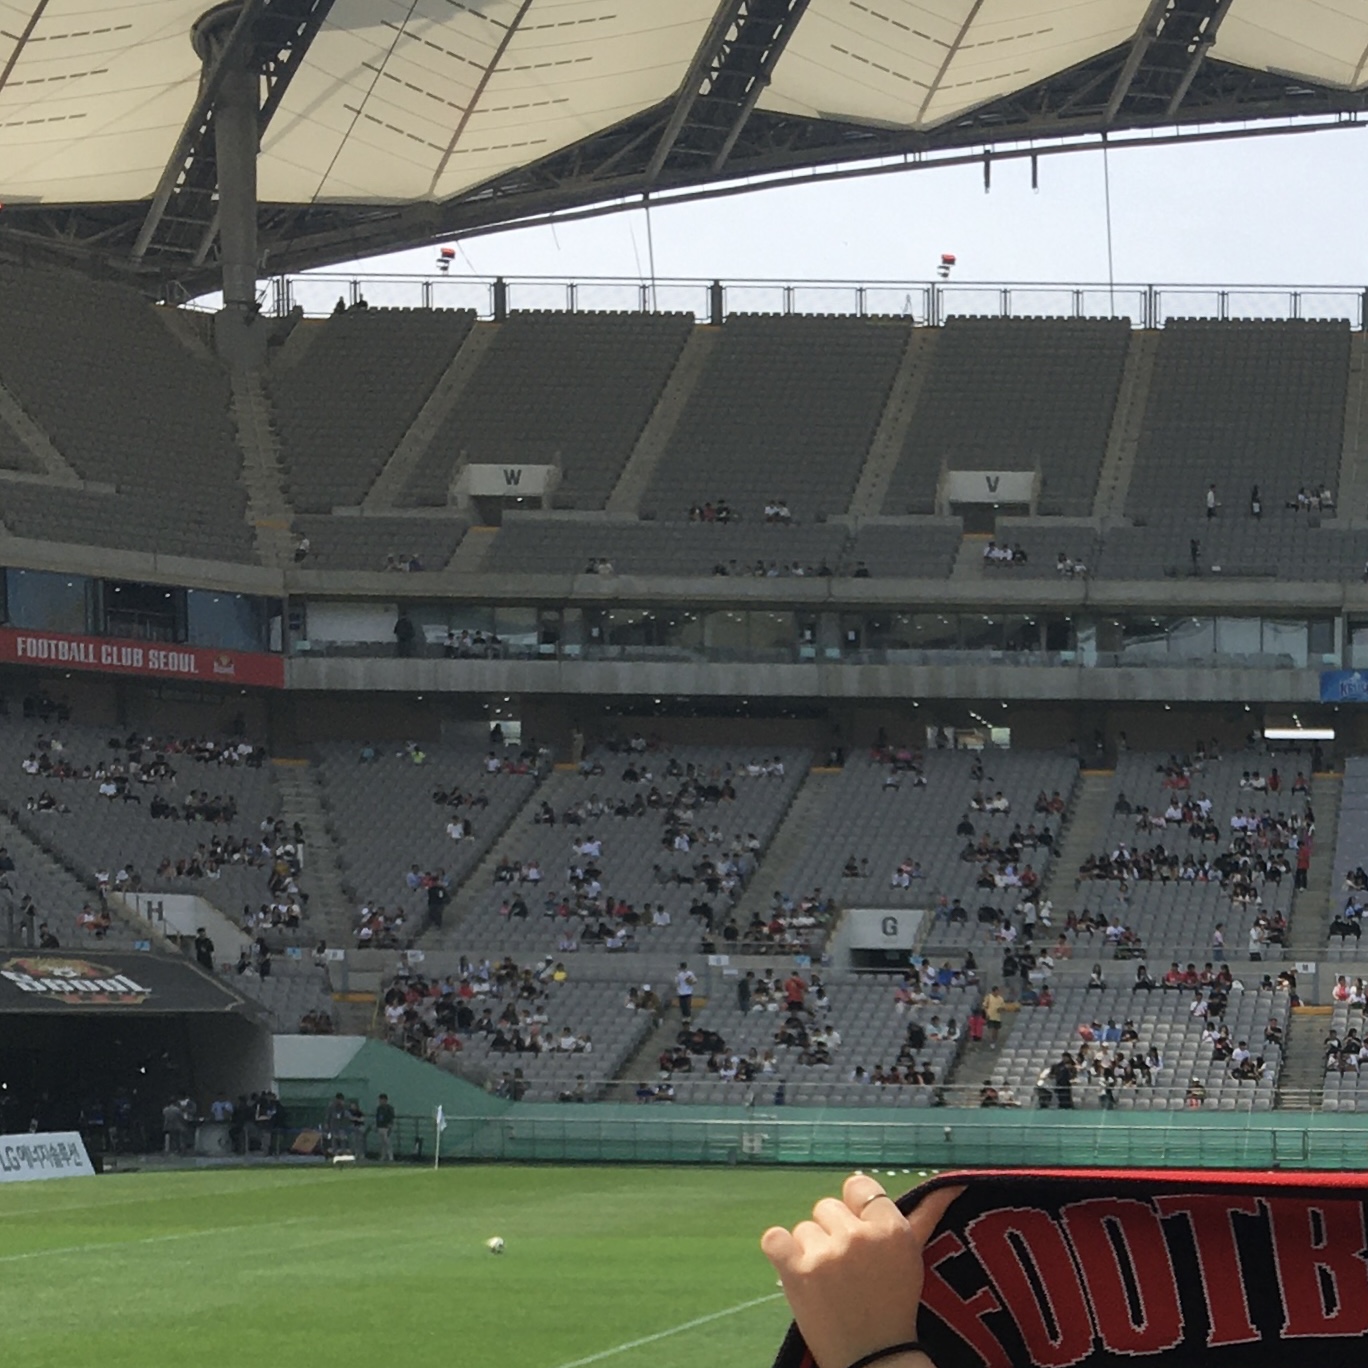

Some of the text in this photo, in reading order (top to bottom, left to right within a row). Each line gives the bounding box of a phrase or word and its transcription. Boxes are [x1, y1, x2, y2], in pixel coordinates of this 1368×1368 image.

[503, 469, 522, 485] W
[985, 476, 999, 493] V
[16, 636, 98, 664] FOOTBALL
[101, 645, 144, 668] CLUB
[148, 650, 199, 674] SEOUL
[147, 901, 163, 921] H
[881, 916, 899, 937] G
